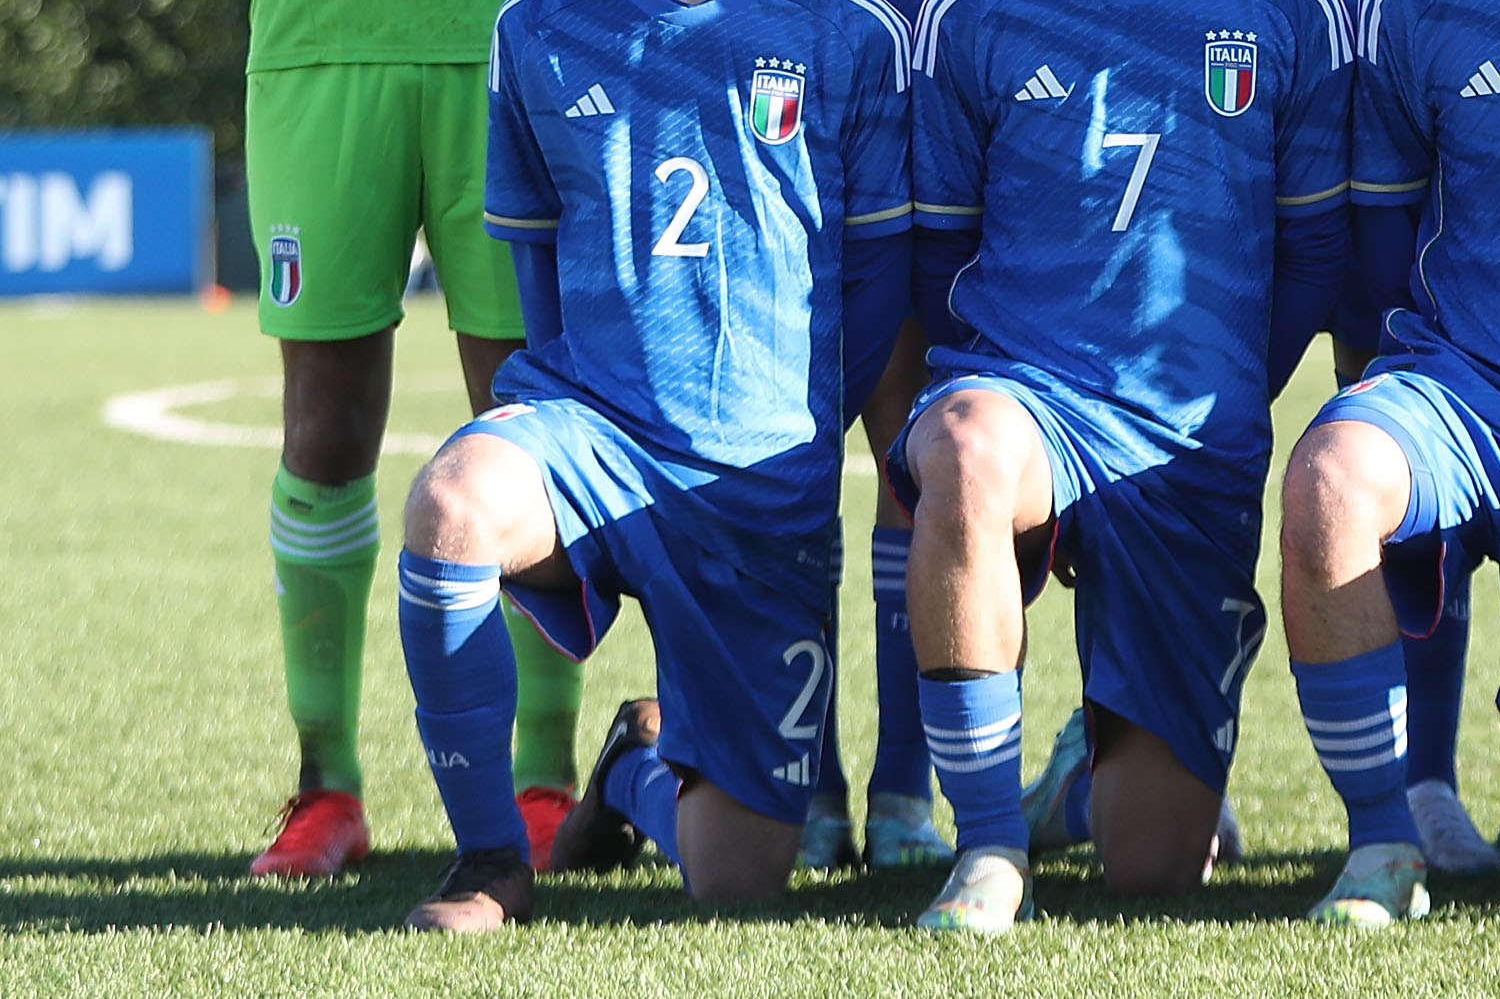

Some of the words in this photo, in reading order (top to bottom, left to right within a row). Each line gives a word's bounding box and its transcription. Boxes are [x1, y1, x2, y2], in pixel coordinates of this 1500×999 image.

[757, 75, 799, 93] ITALIA
[1210, 48, 1251, 63] ITALIA
[651, 157, 710, 257] 2
[1101, 133, 1160, 232] 7
[273, 241, 298, 255] ITALIA
[779, 639, 825, 740] 2
